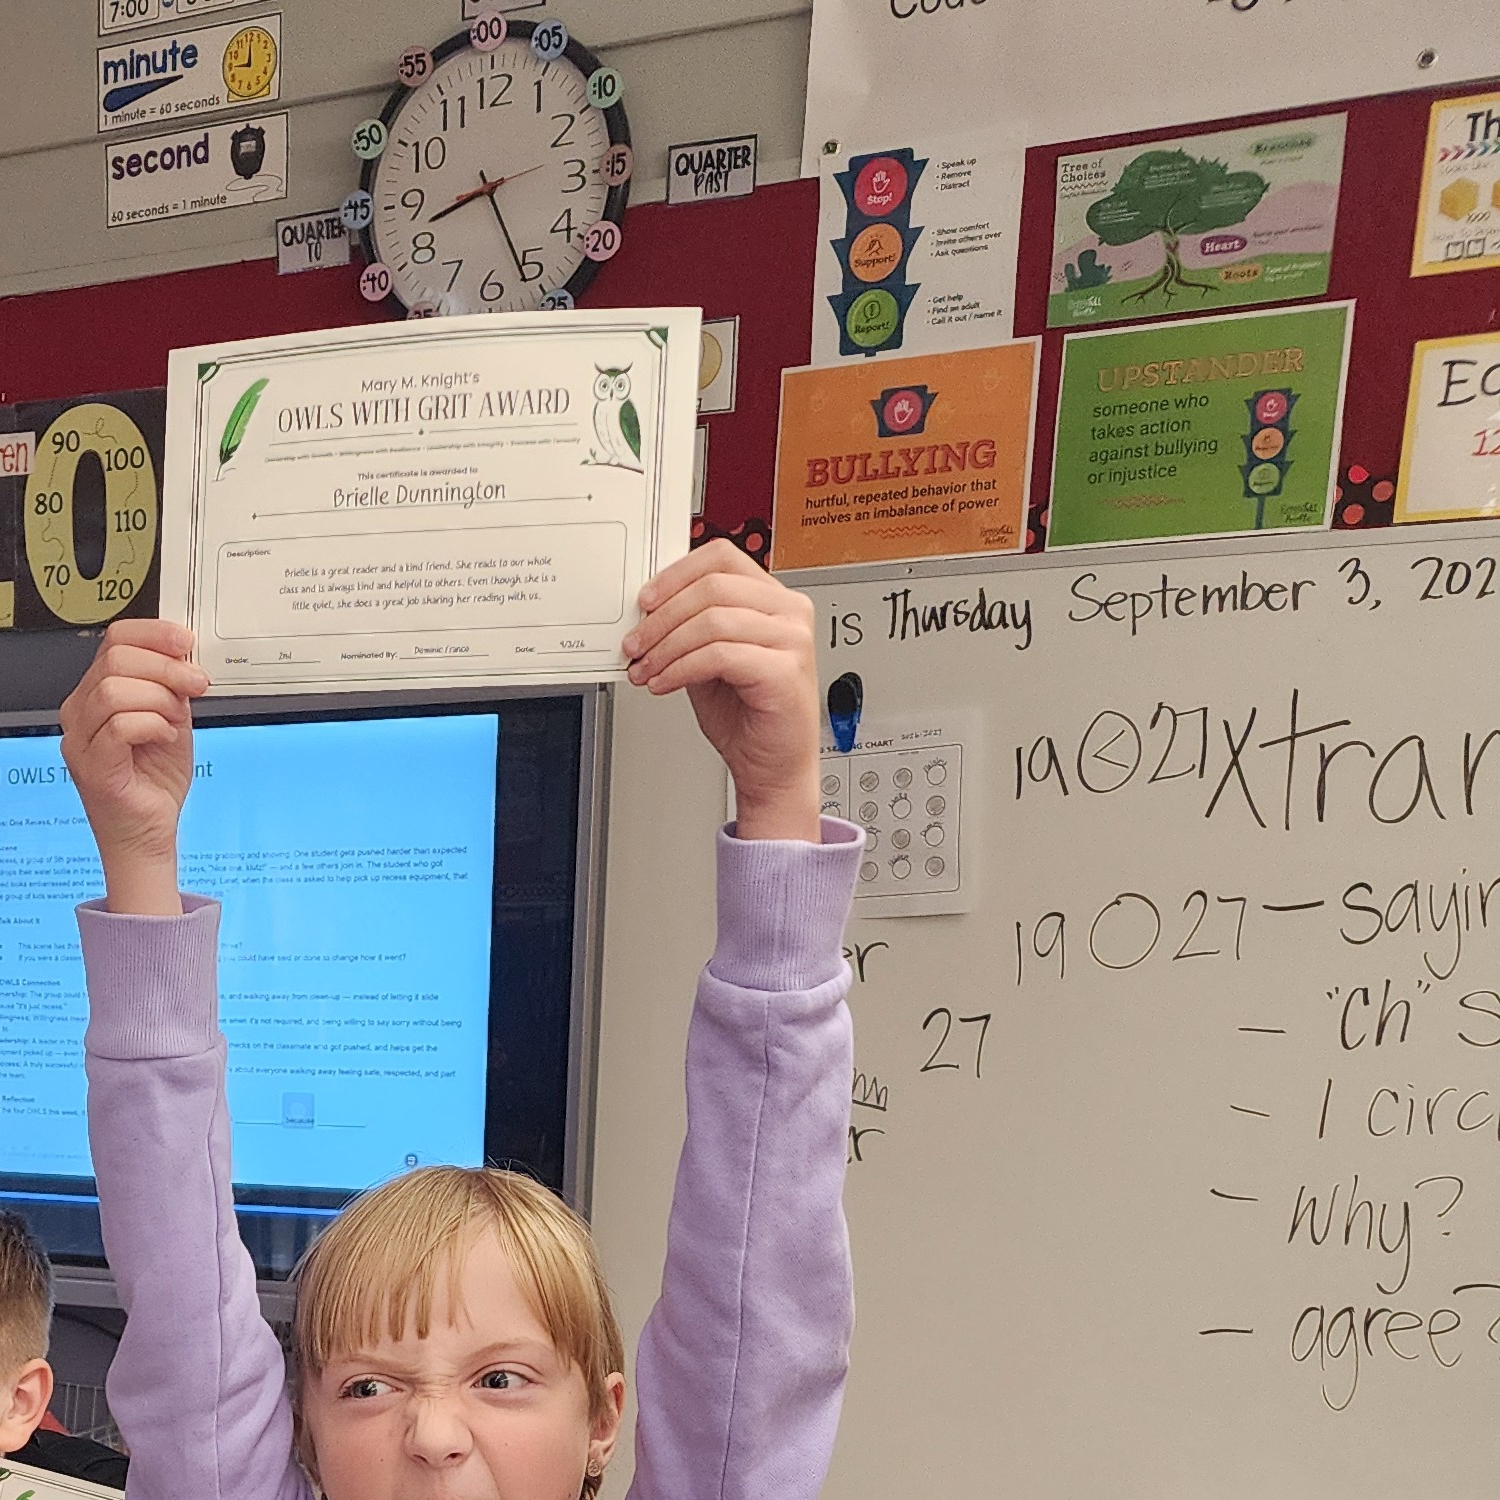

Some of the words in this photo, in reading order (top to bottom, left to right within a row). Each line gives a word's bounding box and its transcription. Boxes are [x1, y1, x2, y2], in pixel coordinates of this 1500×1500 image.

[471, 17, 500, 43] :00
[534, 25, 563, 52] :05
[103, 40, 198, 85] minute
[400, 53, 426, 78] :55
[477, 74, 513, 110] 12
[533, 79, 542, 114] 1
[592, 74, 616, 100] :10
[111, 109, 148, 125] minute
[160, 103, 172, 115] 60
[174, 95, 220, 112] seconds
[440, 96, 465, 132] 11
[353, 124, 382, 152] :50
[550, 113, 575, 149] 2
[111, 132, 210, 181] second
[412, 136, 446, 173] 10
[606, 152, 627, 176] :15
[675, 146, 752, 176] QUARTER
[561, 159, 586, 194] 3
[694, 171, 730, 196] PAST
[111, 211, 124, 222] 60
[126, 203, 169, 220] seconds
[190, 194, 227, 210] minute
[401, 188, 425, 221] 9
[550, 208, 577, 243] 4
[585, 228, 615, 252] :20
[307, 241, 322, 263] TO
[411, 231, 435, 264] 8
[1204, 239, 1242, 253] Heart
[441, 259, 463, 292] 7
[521, 247, 544, 282] 5
[362, 271, 389, 292] :40
[480, 270, 504, 302] 6
[361, 379, 396, 395] Mary
[400, 375, 417, 389] M.
[421, 371, 480, 389] Knight's
[1098, 347, 1305, 392] UPSTANDER
[277, 402, 344, 434] OWLS
[351, 397, 411, 427] WITH
[418, 393, 474, 422] GRIT
[478, 387, 571, 420] AWARD
[1092, 400, 1170, 418] someone
[1174, 393, 1209, 409] who
[1091, 423, 1135, 440] takes
[1140, 418, 1191, 437] action
[805, 439, 997, 488] BULLYING
[1089, 443, 1149, 465] against
[1154, 437, 1218, 458] bullying
[1087, 472, 1104, 485] or
[1108, 464, 1177, 485] injustice
[333, 481, 390, 509] Brielle
[396, 479, 507, 509] Dunnington
[805, 493, 850, 509] hurtful,
[853, 487, 909, 505] repeated
[912, 482, 967, 498] behavior
[970, 478, 997, 492] that
[801, 511, 851, 527] involves
[854, 510, 870, 521] an
[873, 503, 938, 519] imbalance
[942, 500, 956, 512] of
[958, 496, 999, 513] power
[830, 603, 863, 649] is
[883, 587, 1033, 651] Thursday
[1068, 570, 1316, 636] September
[1338, 557, 1382, 611] 3,
[7, 766, 56, 786] OWLS
[1016, 911, 1067, 987] 19
[1172, 890, 1247, 963] 27
[919, 1006, 991, 1079] 27
[1292, 1304, 1463, 1411] agree
